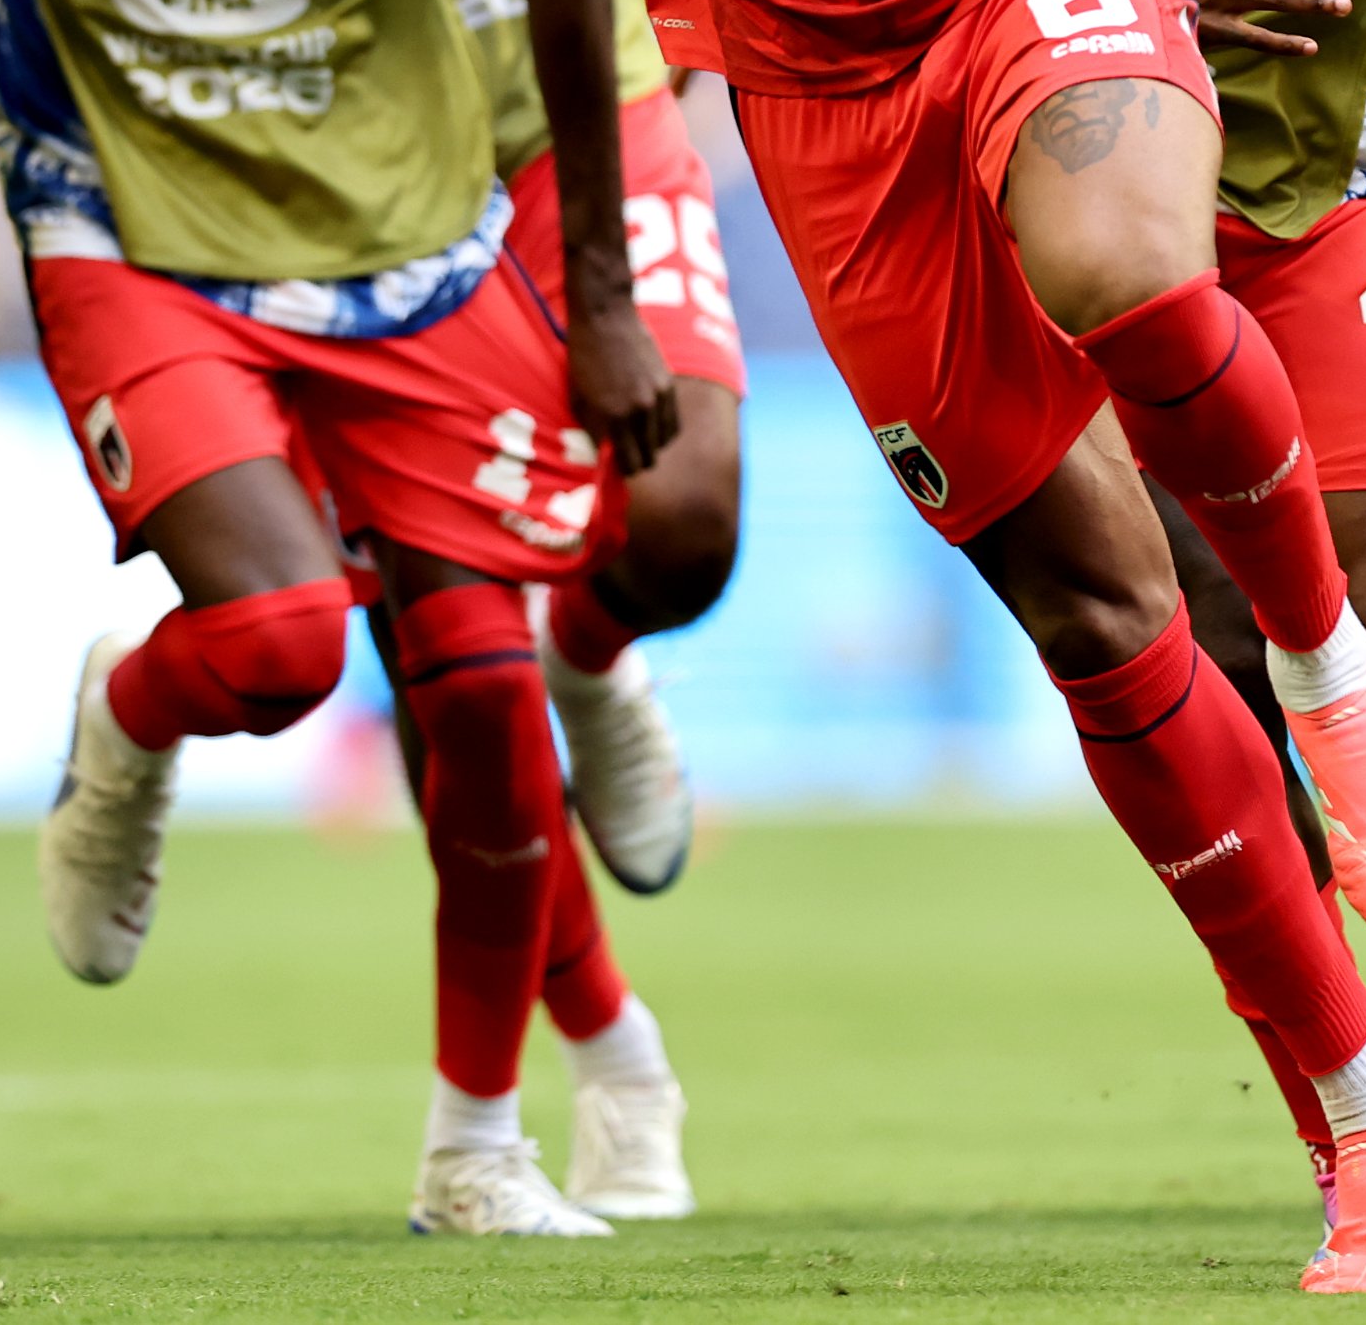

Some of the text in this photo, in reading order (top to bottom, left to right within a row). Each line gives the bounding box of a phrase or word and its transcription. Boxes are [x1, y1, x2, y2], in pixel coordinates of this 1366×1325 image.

[125, 66, 336, 120] 2026
[877, 426, 907, 446] FCF
[1148, 828, 1243, 881] apelli
